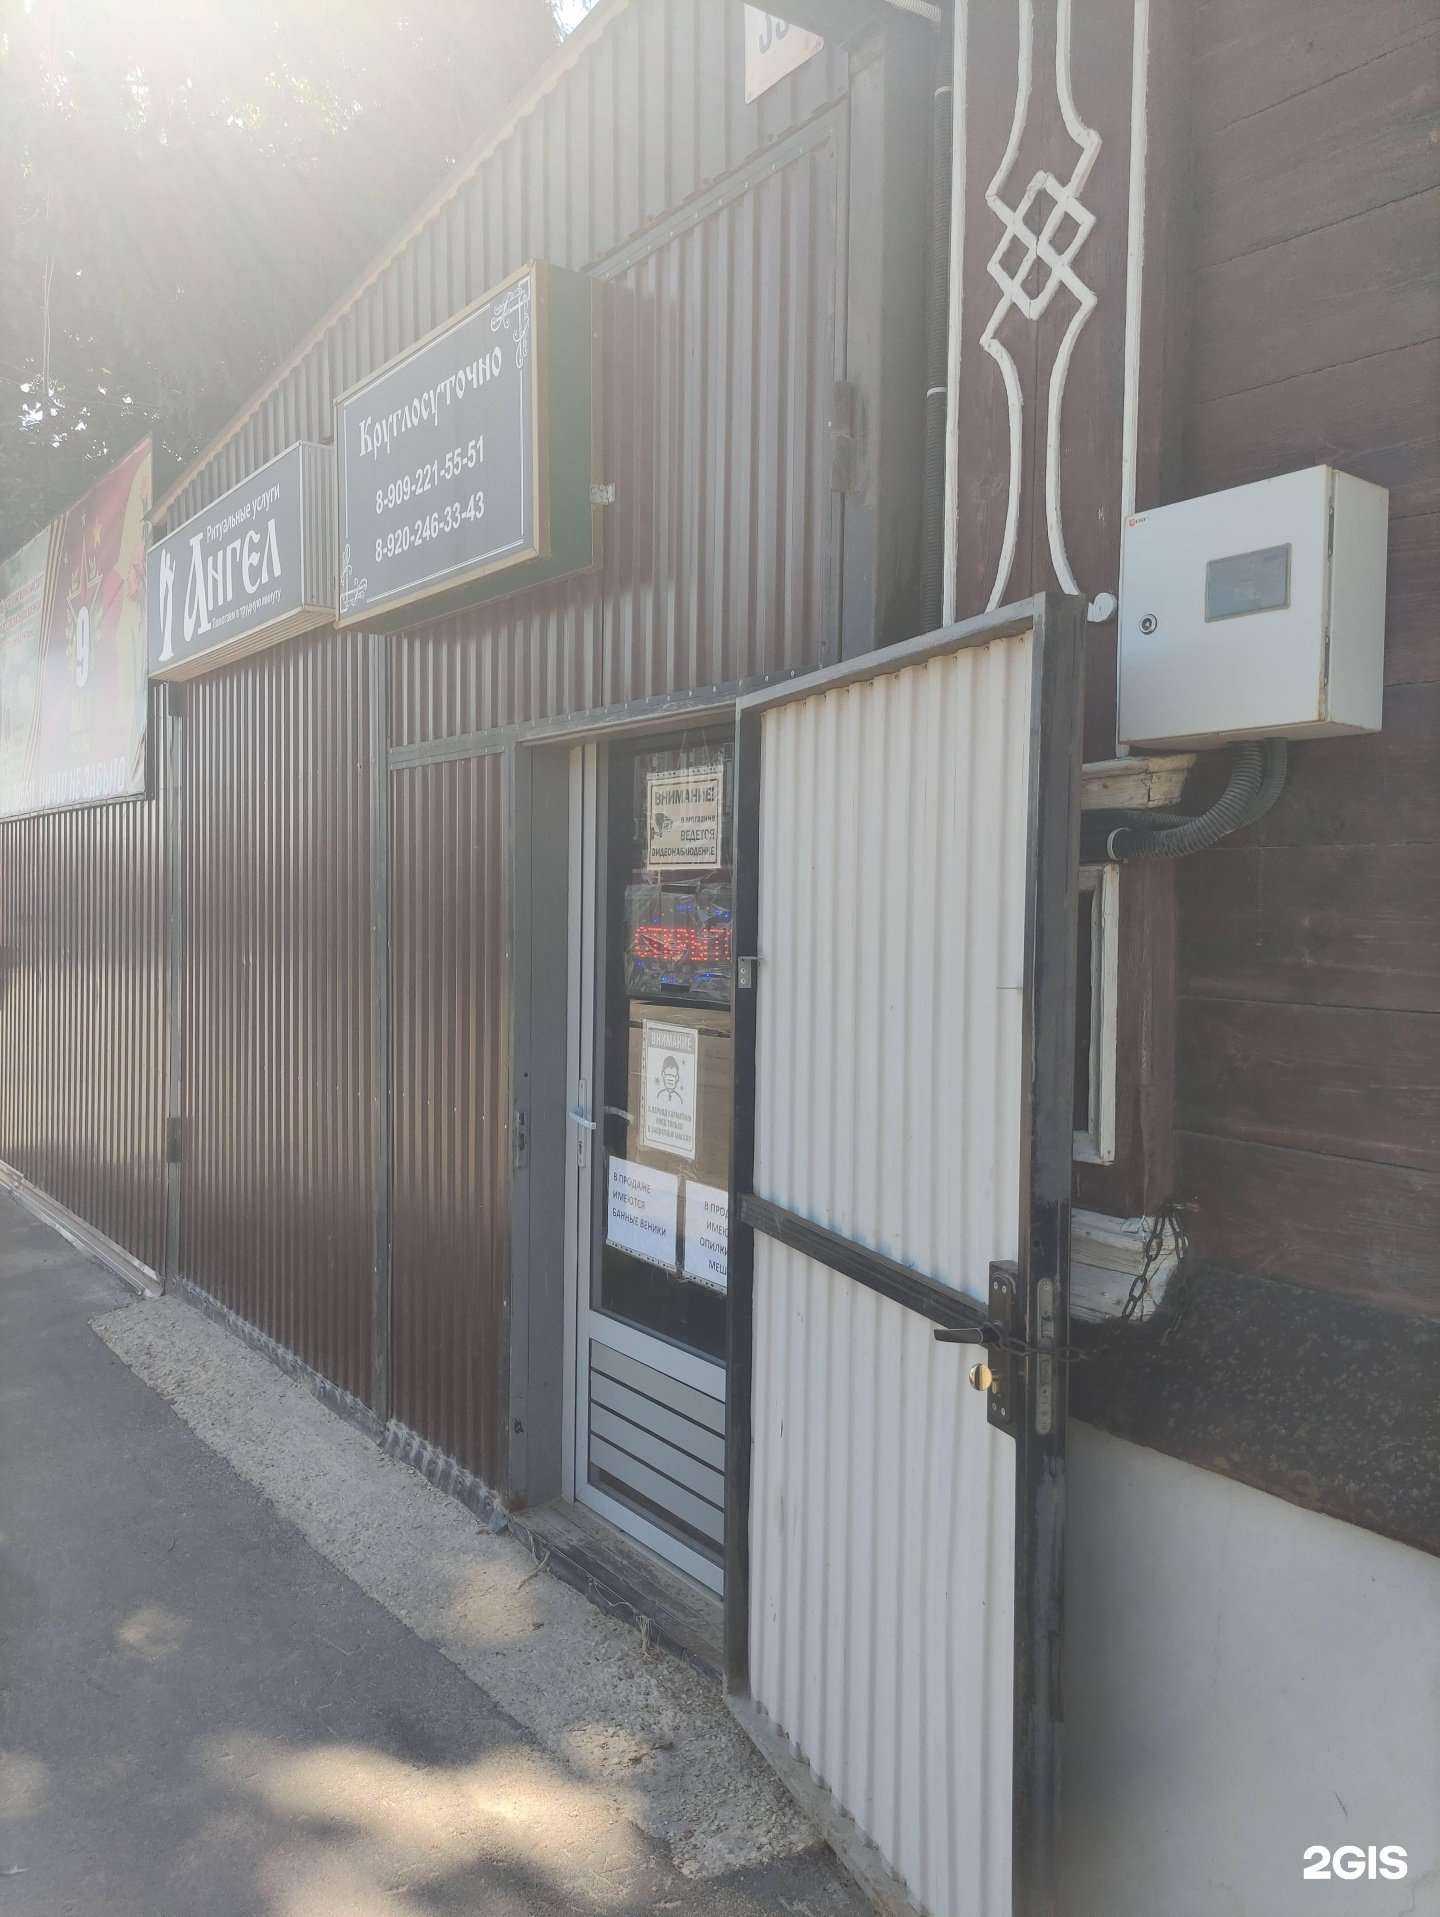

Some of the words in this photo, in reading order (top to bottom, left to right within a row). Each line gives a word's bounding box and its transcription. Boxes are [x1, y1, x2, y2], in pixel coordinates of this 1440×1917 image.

[359, 346, 502, 460] Круглосуточно
[375, 435, 485, 514] 8-909-221-55-51
[207, 502, 251, 543] Ритуальные
[252, 482, 281, 522] услуги
[375, 491, 485, 562] 8-920-246-33-43
[612, 1191, 645, 1209] ИМЕЮТСЯ
[613, 1171, 617, 1181] В
[619, 1174, 651, 1194] ПРОДАЖЕ
[704, 1200, 709, 1210] В
[612, 1207, 639, 1227] БАННЫЕ
[640, 1219, 666, 1237] ВЕНИКИ
